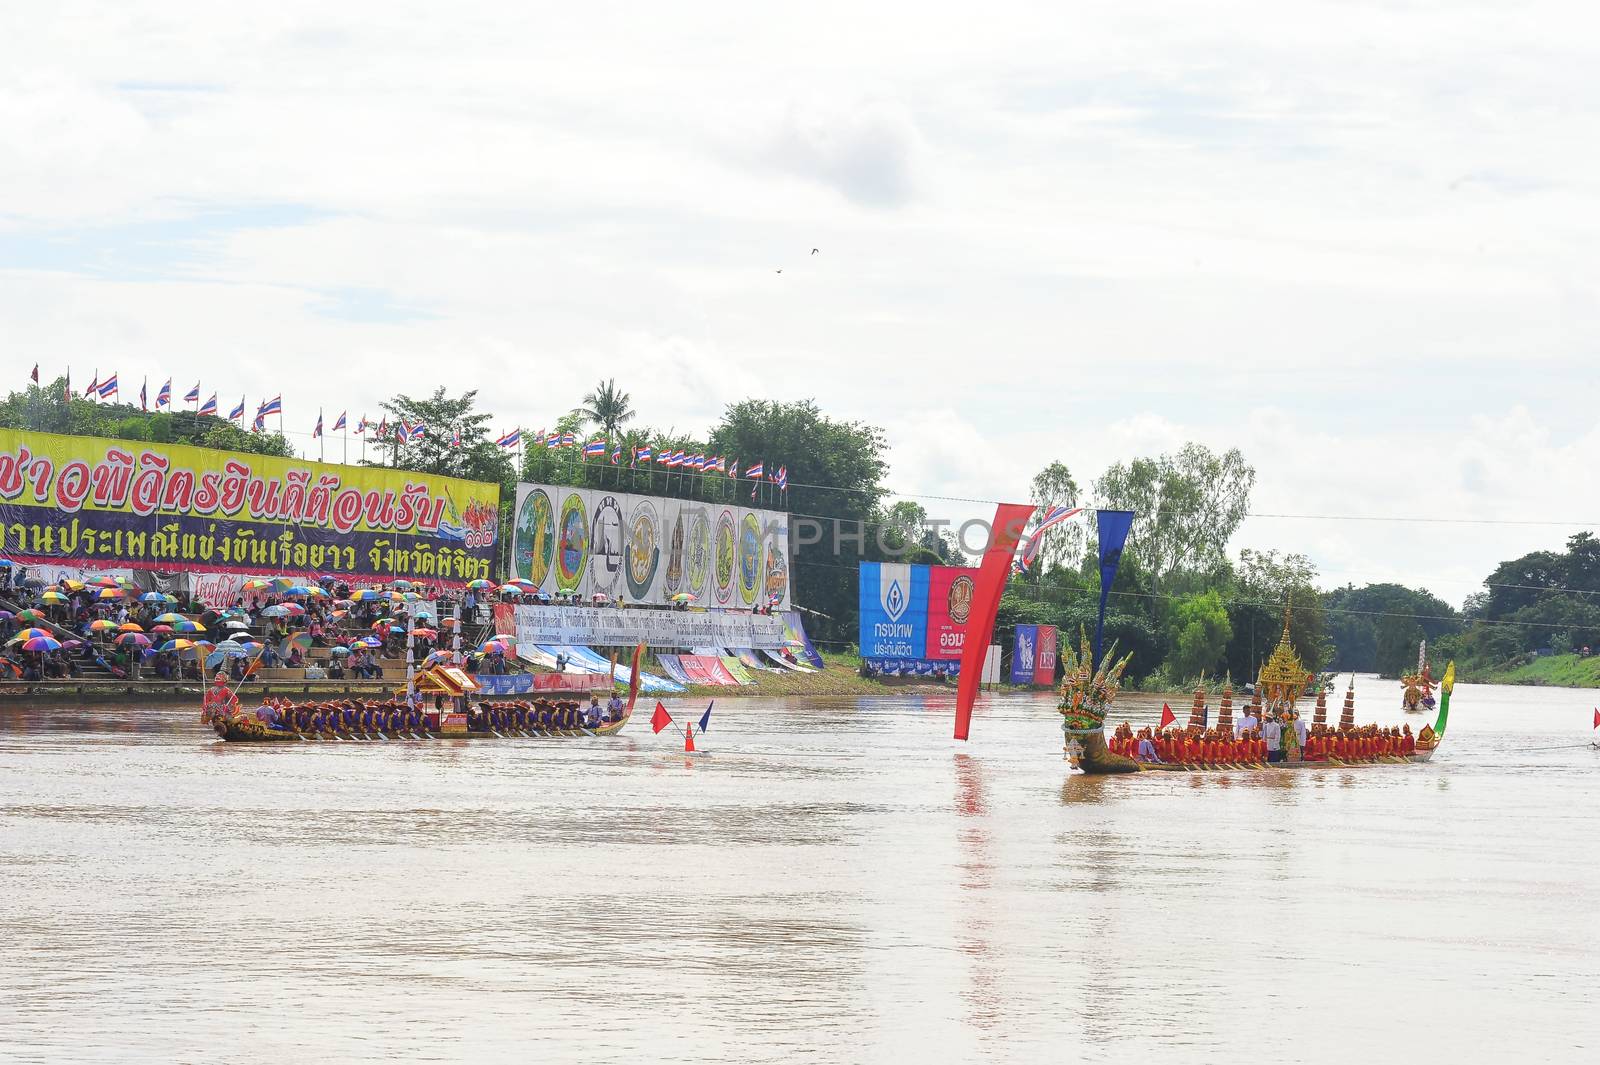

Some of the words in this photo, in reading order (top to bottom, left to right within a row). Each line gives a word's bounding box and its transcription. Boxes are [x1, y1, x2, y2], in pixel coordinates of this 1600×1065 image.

[368, 538, 492, 580] จังหวัดพิจิตร
